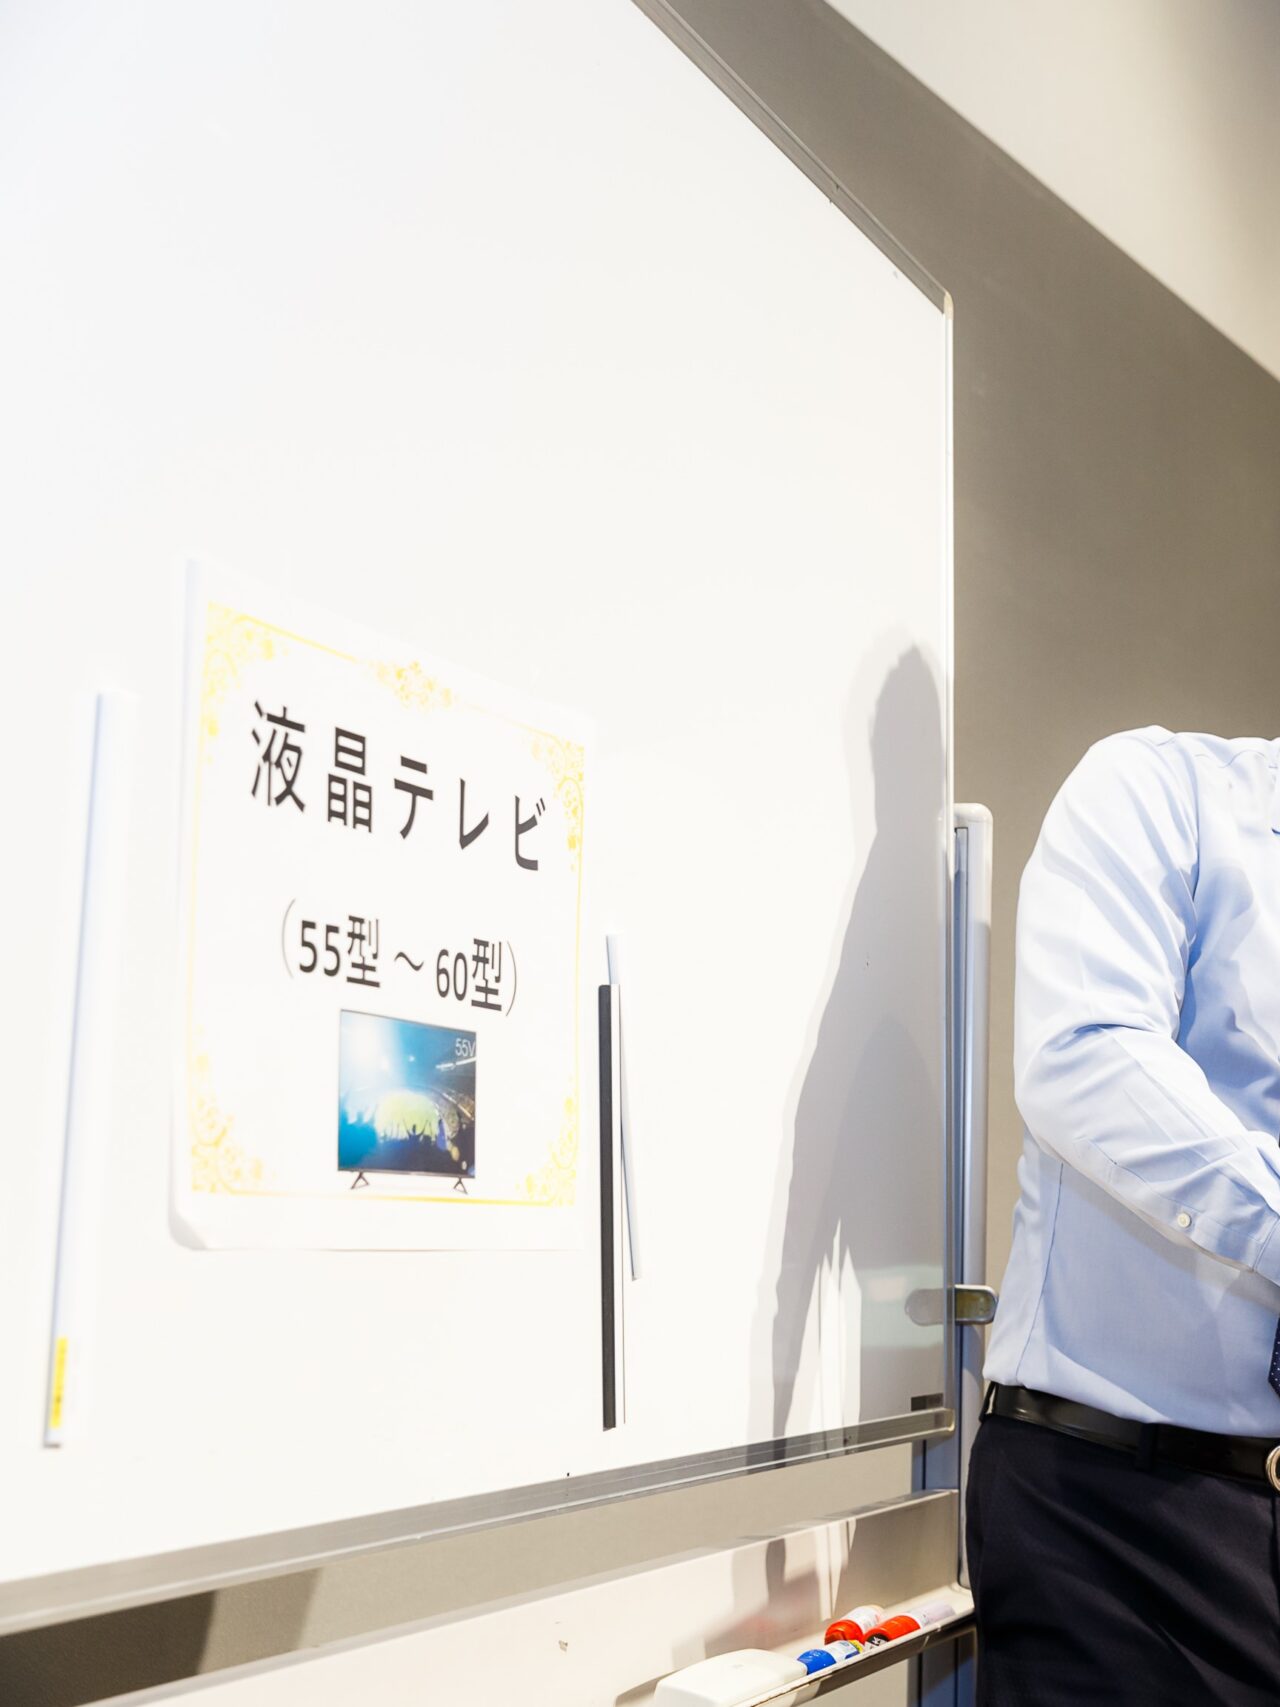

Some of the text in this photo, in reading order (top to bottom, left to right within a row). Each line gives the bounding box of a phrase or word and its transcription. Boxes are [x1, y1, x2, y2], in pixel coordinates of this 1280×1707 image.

[250, 699, 546, 871] 液晶テレビ
